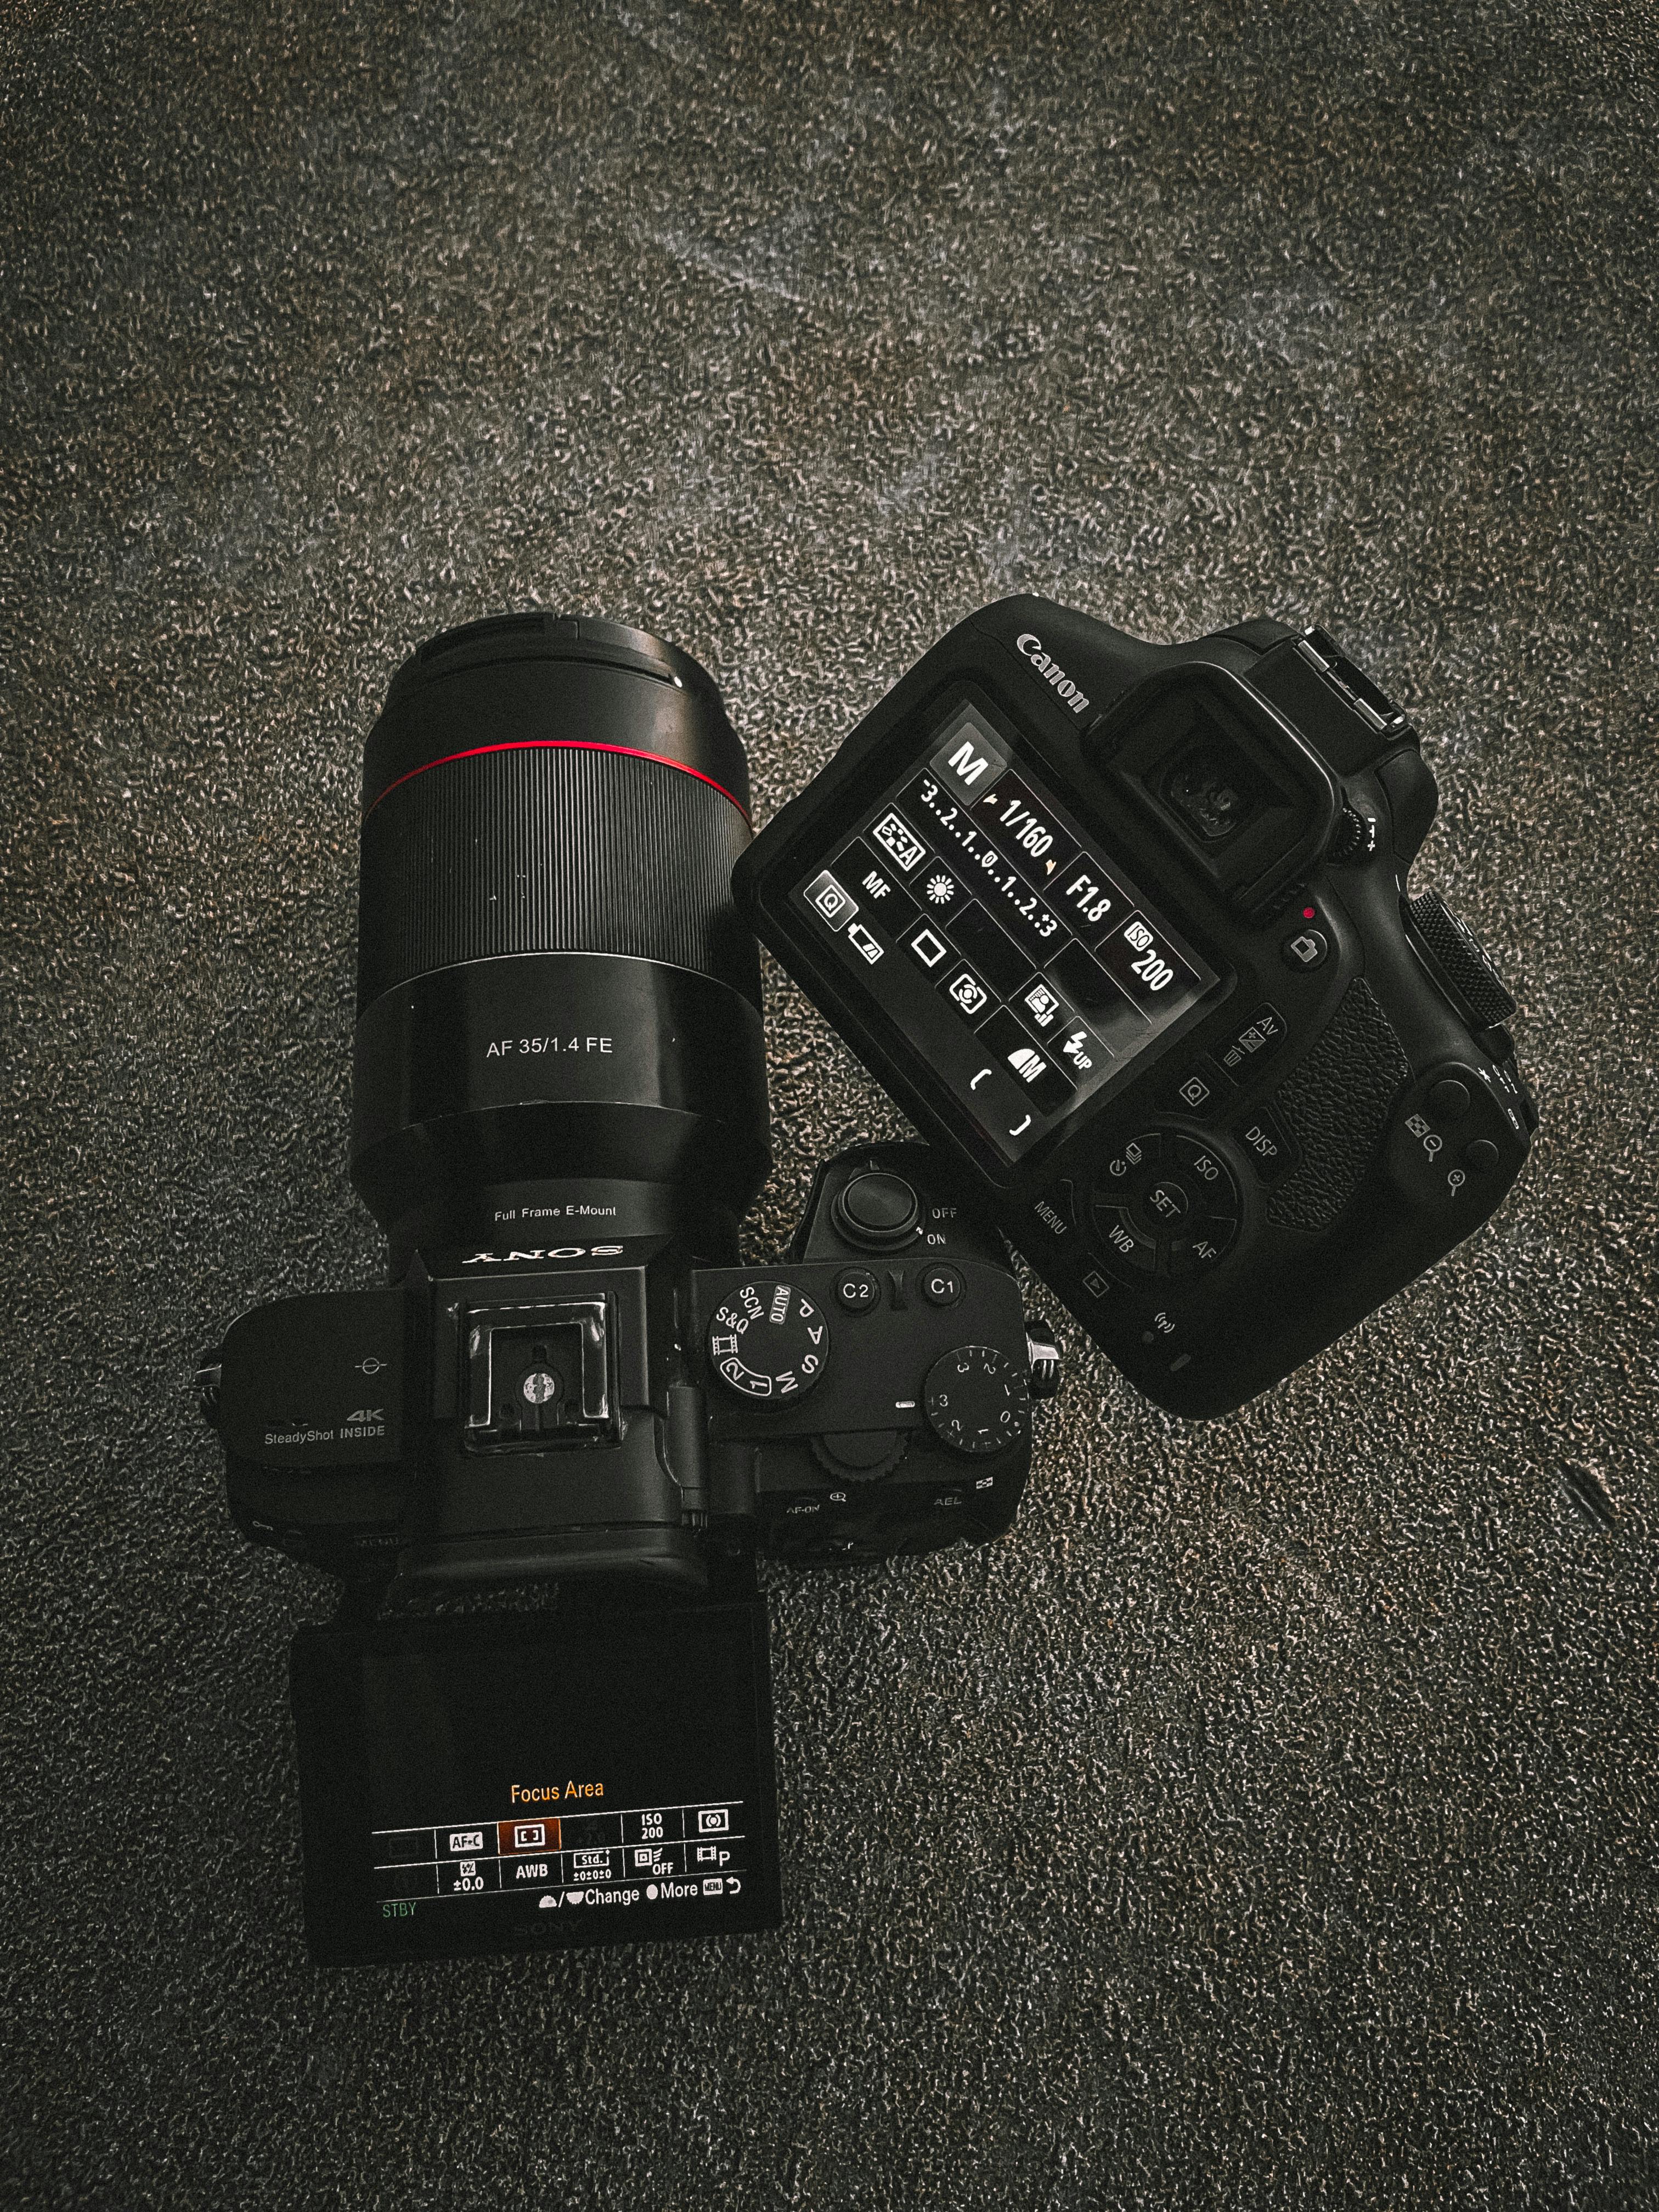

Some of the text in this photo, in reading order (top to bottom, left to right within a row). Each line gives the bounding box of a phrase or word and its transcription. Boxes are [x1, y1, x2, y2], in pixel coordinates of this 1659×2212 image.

[1017, 634, 1089, 713] Canon
[948, 742, 989, 785] M
[999, 800, 1053, 857] 1/160
[862, 871, 891, 899] MF
[1066, 875, 1111, 922] F1.8
[1125, 923, 1152, 949] ISO
[1131, 950, 1173, 991] 200
[486, 1037, 613, 1058] AF 35/1.4 FE
[1073, 1051, 1092, 1070] UP
[1245, 1126, 1278, 1157] DISP
[1194, 1155, 1218, 1181] ISO
[932, 1207, 957, 1219] OFF
[1149, 1189, 1181, 1218] SET
[494, 1205, 617, 1222] Full Frame E-Mount
[1034, 1201, 1067, 1234] MENU
[927, 1234, 946, 1245] ON
[1109, 1225, 1134, 1253] WB
[462, 1245, 623, 1263] SONY
[1192, 1240, 1216, 1260] AF
[843, 1283, 869, 1299] C2
[931, 1279, 955, 1294] C1
[740, 1286, 764, 1320] SCN
[770, 1285, 789, 1323] AUTO
[799, 1298, 815, 1318] P
[716, 1307, 749, 1334] S&Q
[807, 1325, 823, 1345] A
[726, 1362, 744, 1381] 2
[802, 1354, 819, 1374] S
[957, 1362, 969, 1373] 3
[749, 1380, 768, 1389] 1
[775, 1370, 798, 1393] M
[939, 1394, 949, 1407] 3
[346, 1408, 385, 1422] 4K
[264, 1426, 385, 1445] SteadyShot INSIDE
[786, 1504, 820, 1514] AF-ON
[934, 1497, 962, 1506] AEL
[511, 1780, 604, 1803] Focus Area
[641, 1813, 662, 1826] ISO
[641, 1826, 663, 1839] 200
[582, 1854, 603, 1866] Std.
[719, 1851, 730, 1866] P
[516, 1864, 549, 1879] AWB
[652, 1862, 674, 1876] OFF
[585, 1888, 640, 1906] Change
[661, 1882, 698, 1899] More
[382, 1901, 417, 1918] STBY
